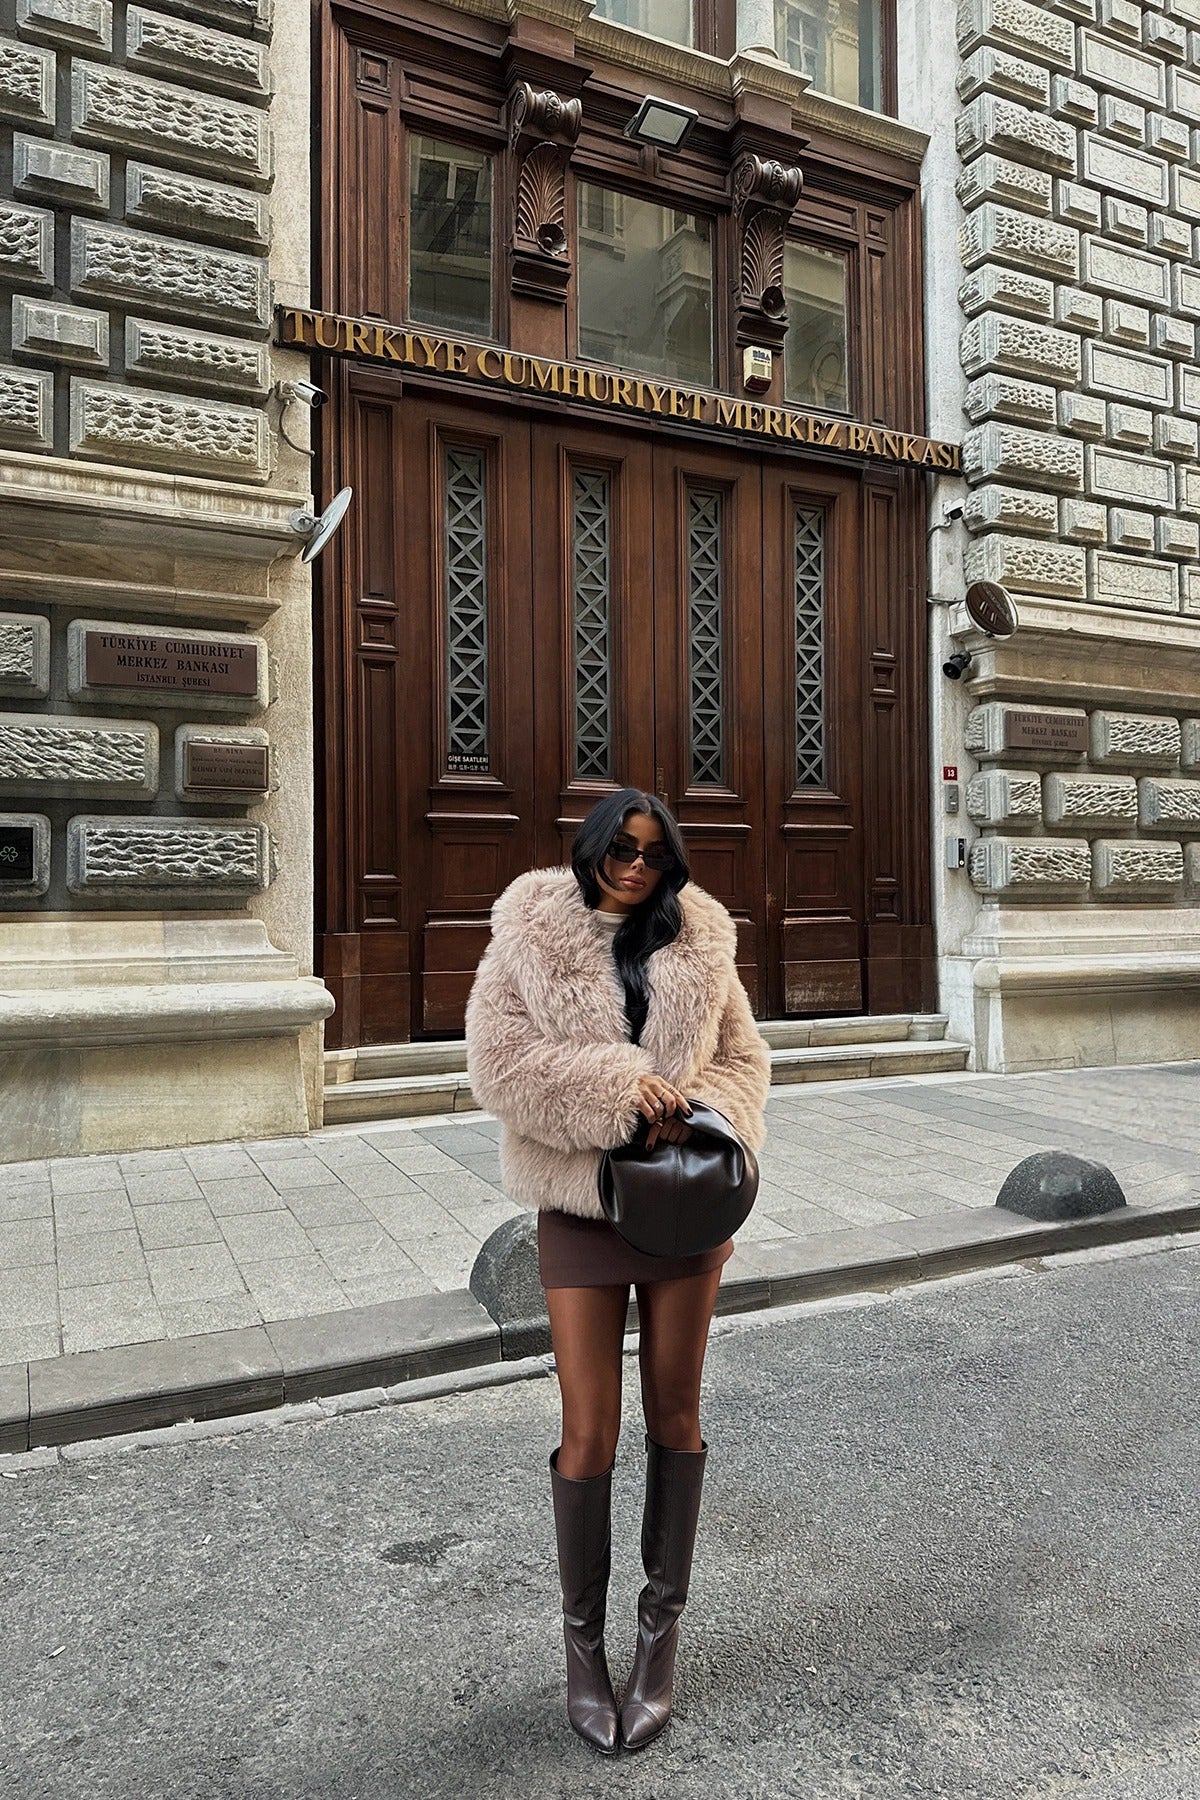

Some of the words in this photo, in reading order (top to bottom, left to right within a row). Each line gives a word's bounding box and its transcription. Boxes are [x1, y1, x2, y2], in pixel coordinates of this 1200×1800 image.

[715, 397, 842, 448] MERKEZ
[848, 424, 962, 471] BANKASI
[101, 636, 157, 651] TÜRKİYE
[165, 642, 244, 659] CUMHURİYET
[117, 655, 168, 669] MERKEZ
[176, 659, 229, 675] BANKASI
[947, 769, 955, 777] 13
